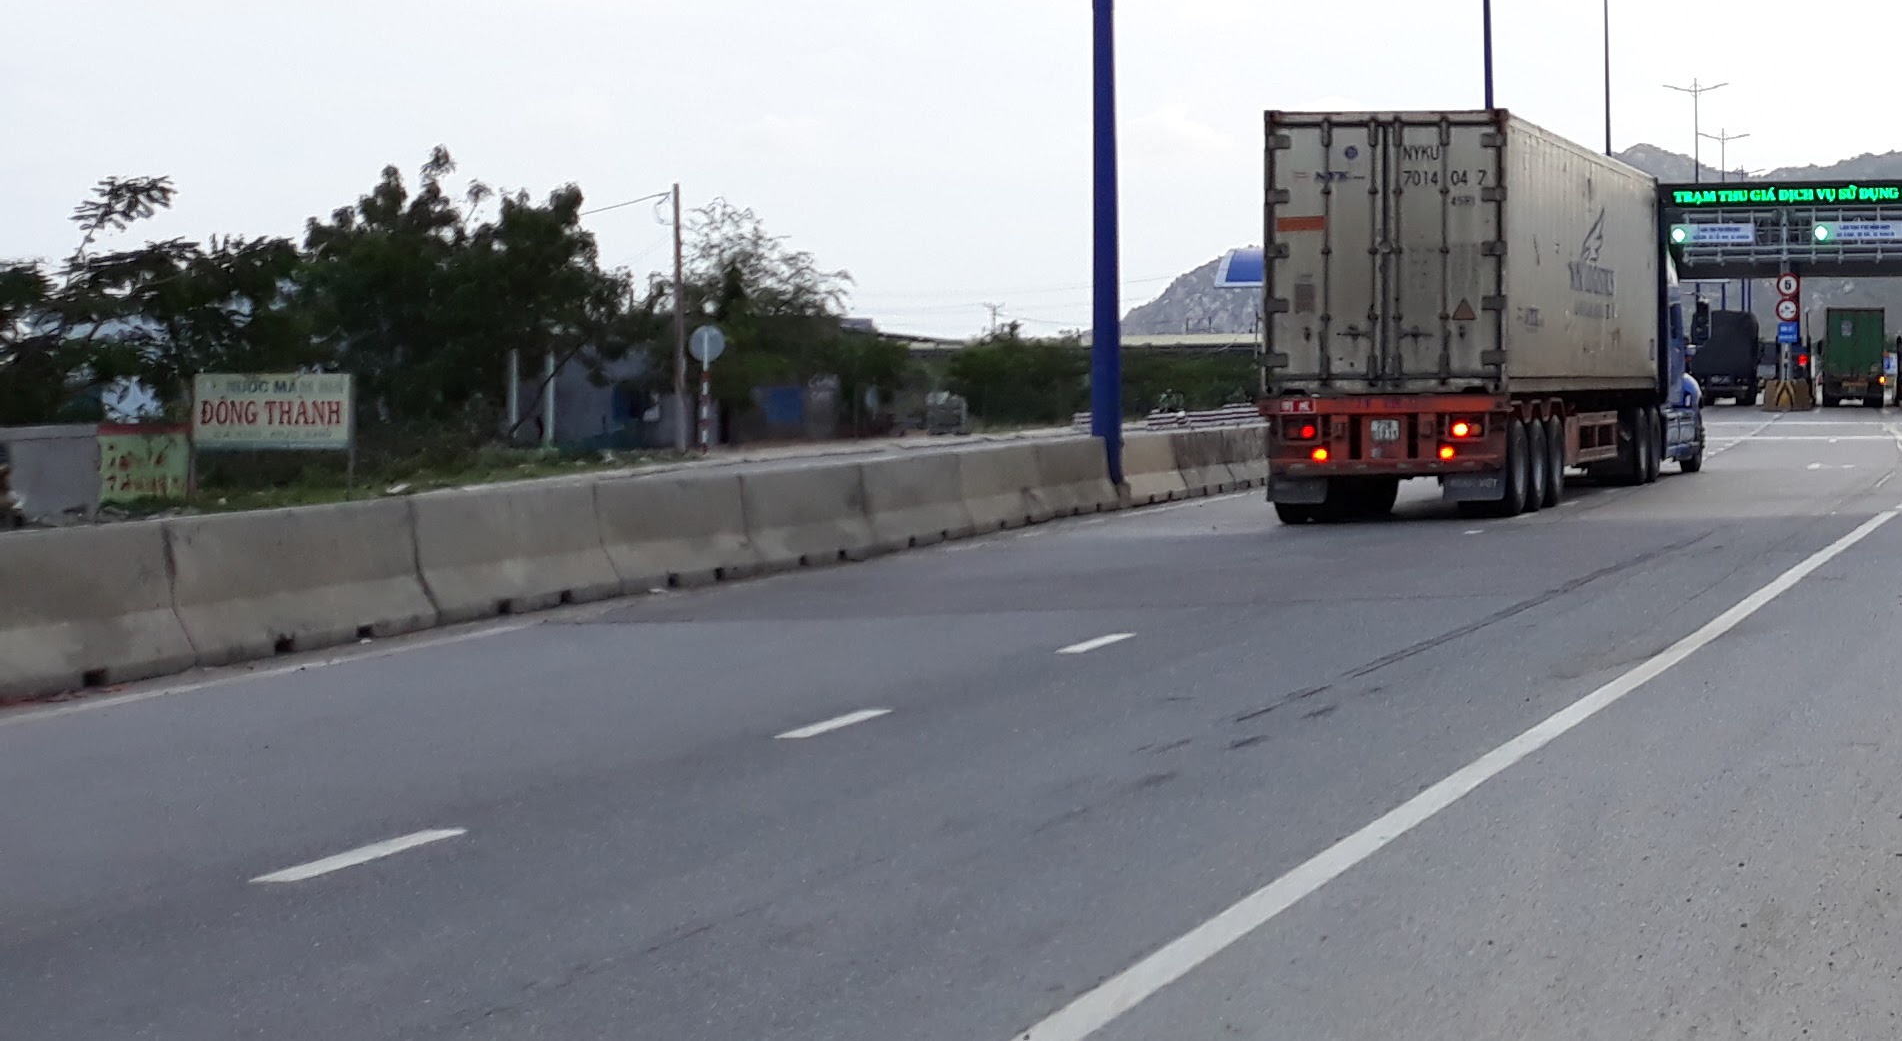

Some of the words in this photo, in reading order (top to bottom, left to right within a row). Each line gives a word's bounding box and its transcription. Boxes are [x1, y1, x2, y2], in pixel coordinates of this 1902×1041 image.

[1403, 144, 1440, 160] NYKU
[1403, 170, 1439, 186] 7014
[1673, 190, 1717, 205] TRẠM
[1718, 189, 1748, 202] THU
[1749, 186, 1776, 202] GIÁ
[1816, 188, 1836, 202] VỤ
[264, 396, 341, 426] THÀNH
